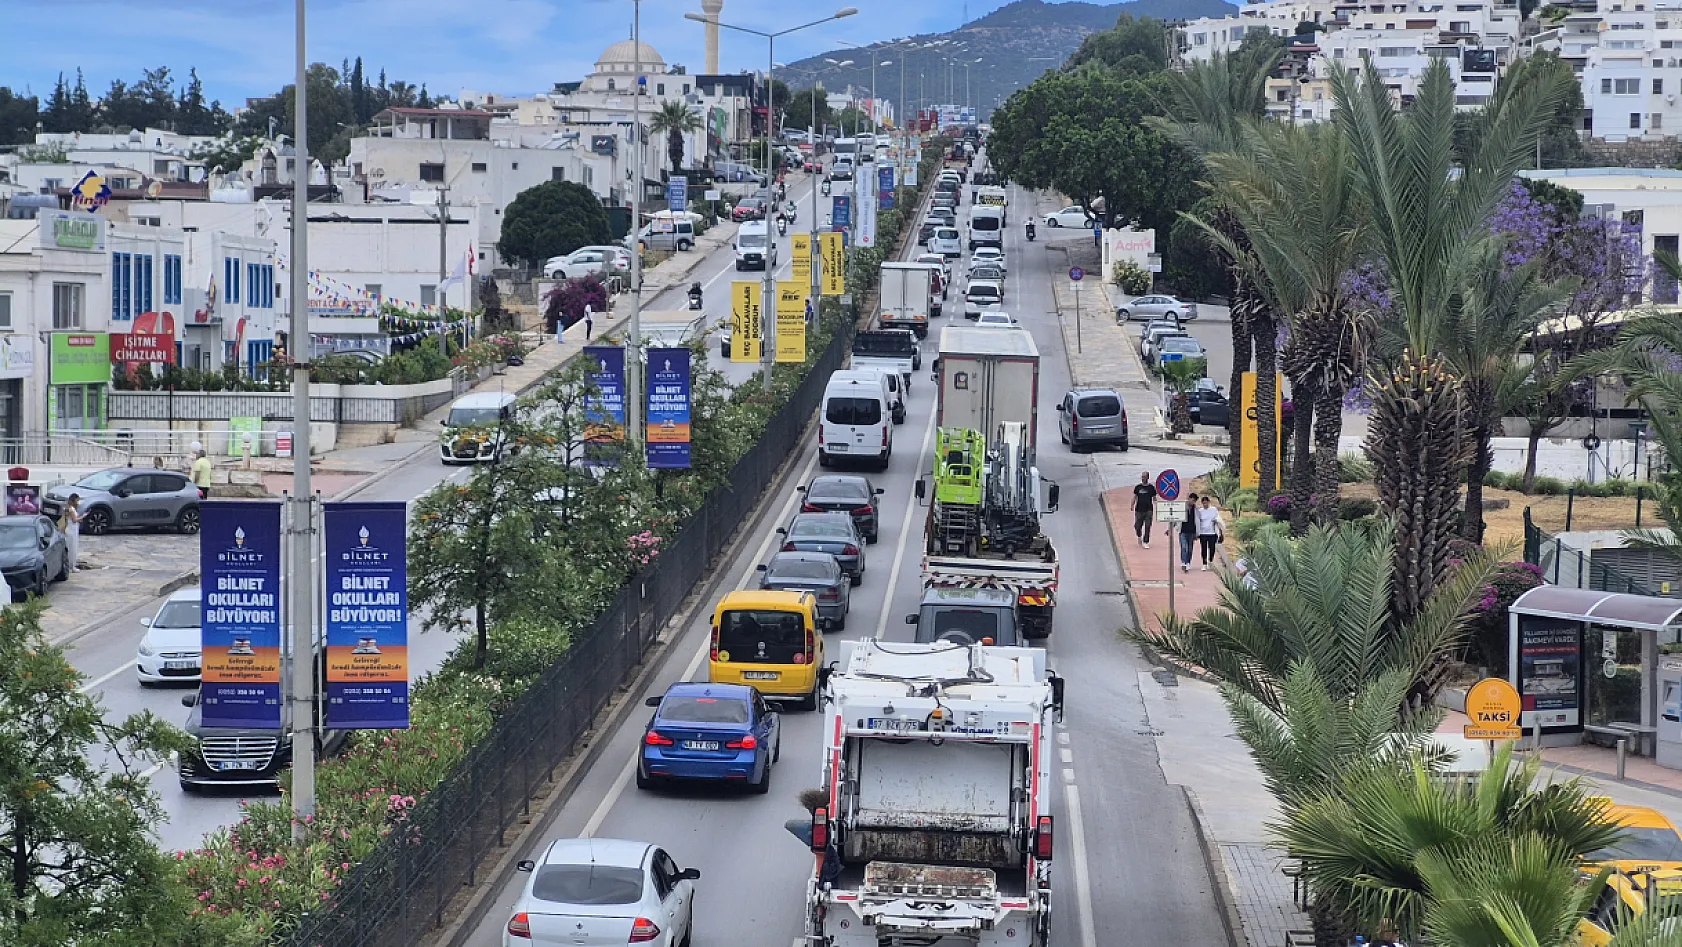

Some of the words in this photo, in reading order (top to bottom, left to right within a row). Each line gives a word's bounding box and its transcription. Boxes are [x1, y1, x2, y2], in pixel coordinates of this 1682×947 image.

[124, 334, 157, 349] İŞİTME
[115, 348, 167, 360] CİHAZLARI
[655, 384, 682, 394] BİLNET
[650, 394, 686, 403] OKULLARI
[649, 402, 687, 411] BÜYÜYOR!
[218, 552, 264, 561] BİLNET
[342, 551, 389, 560] BİLNET
[217, 574, 265, 591] BİLNET
[342, 573, 390, 590] BİLNET
[208, 593, 274, 607] OKULLARI
[332, 592, 400, 606] OKULLARI
[206, 607, 276, 624] BÜYÜYOR!
[330, 606, 402, 622] BÜYÜYOR!
[1477, 711, 1510, 721] TAKSİ
